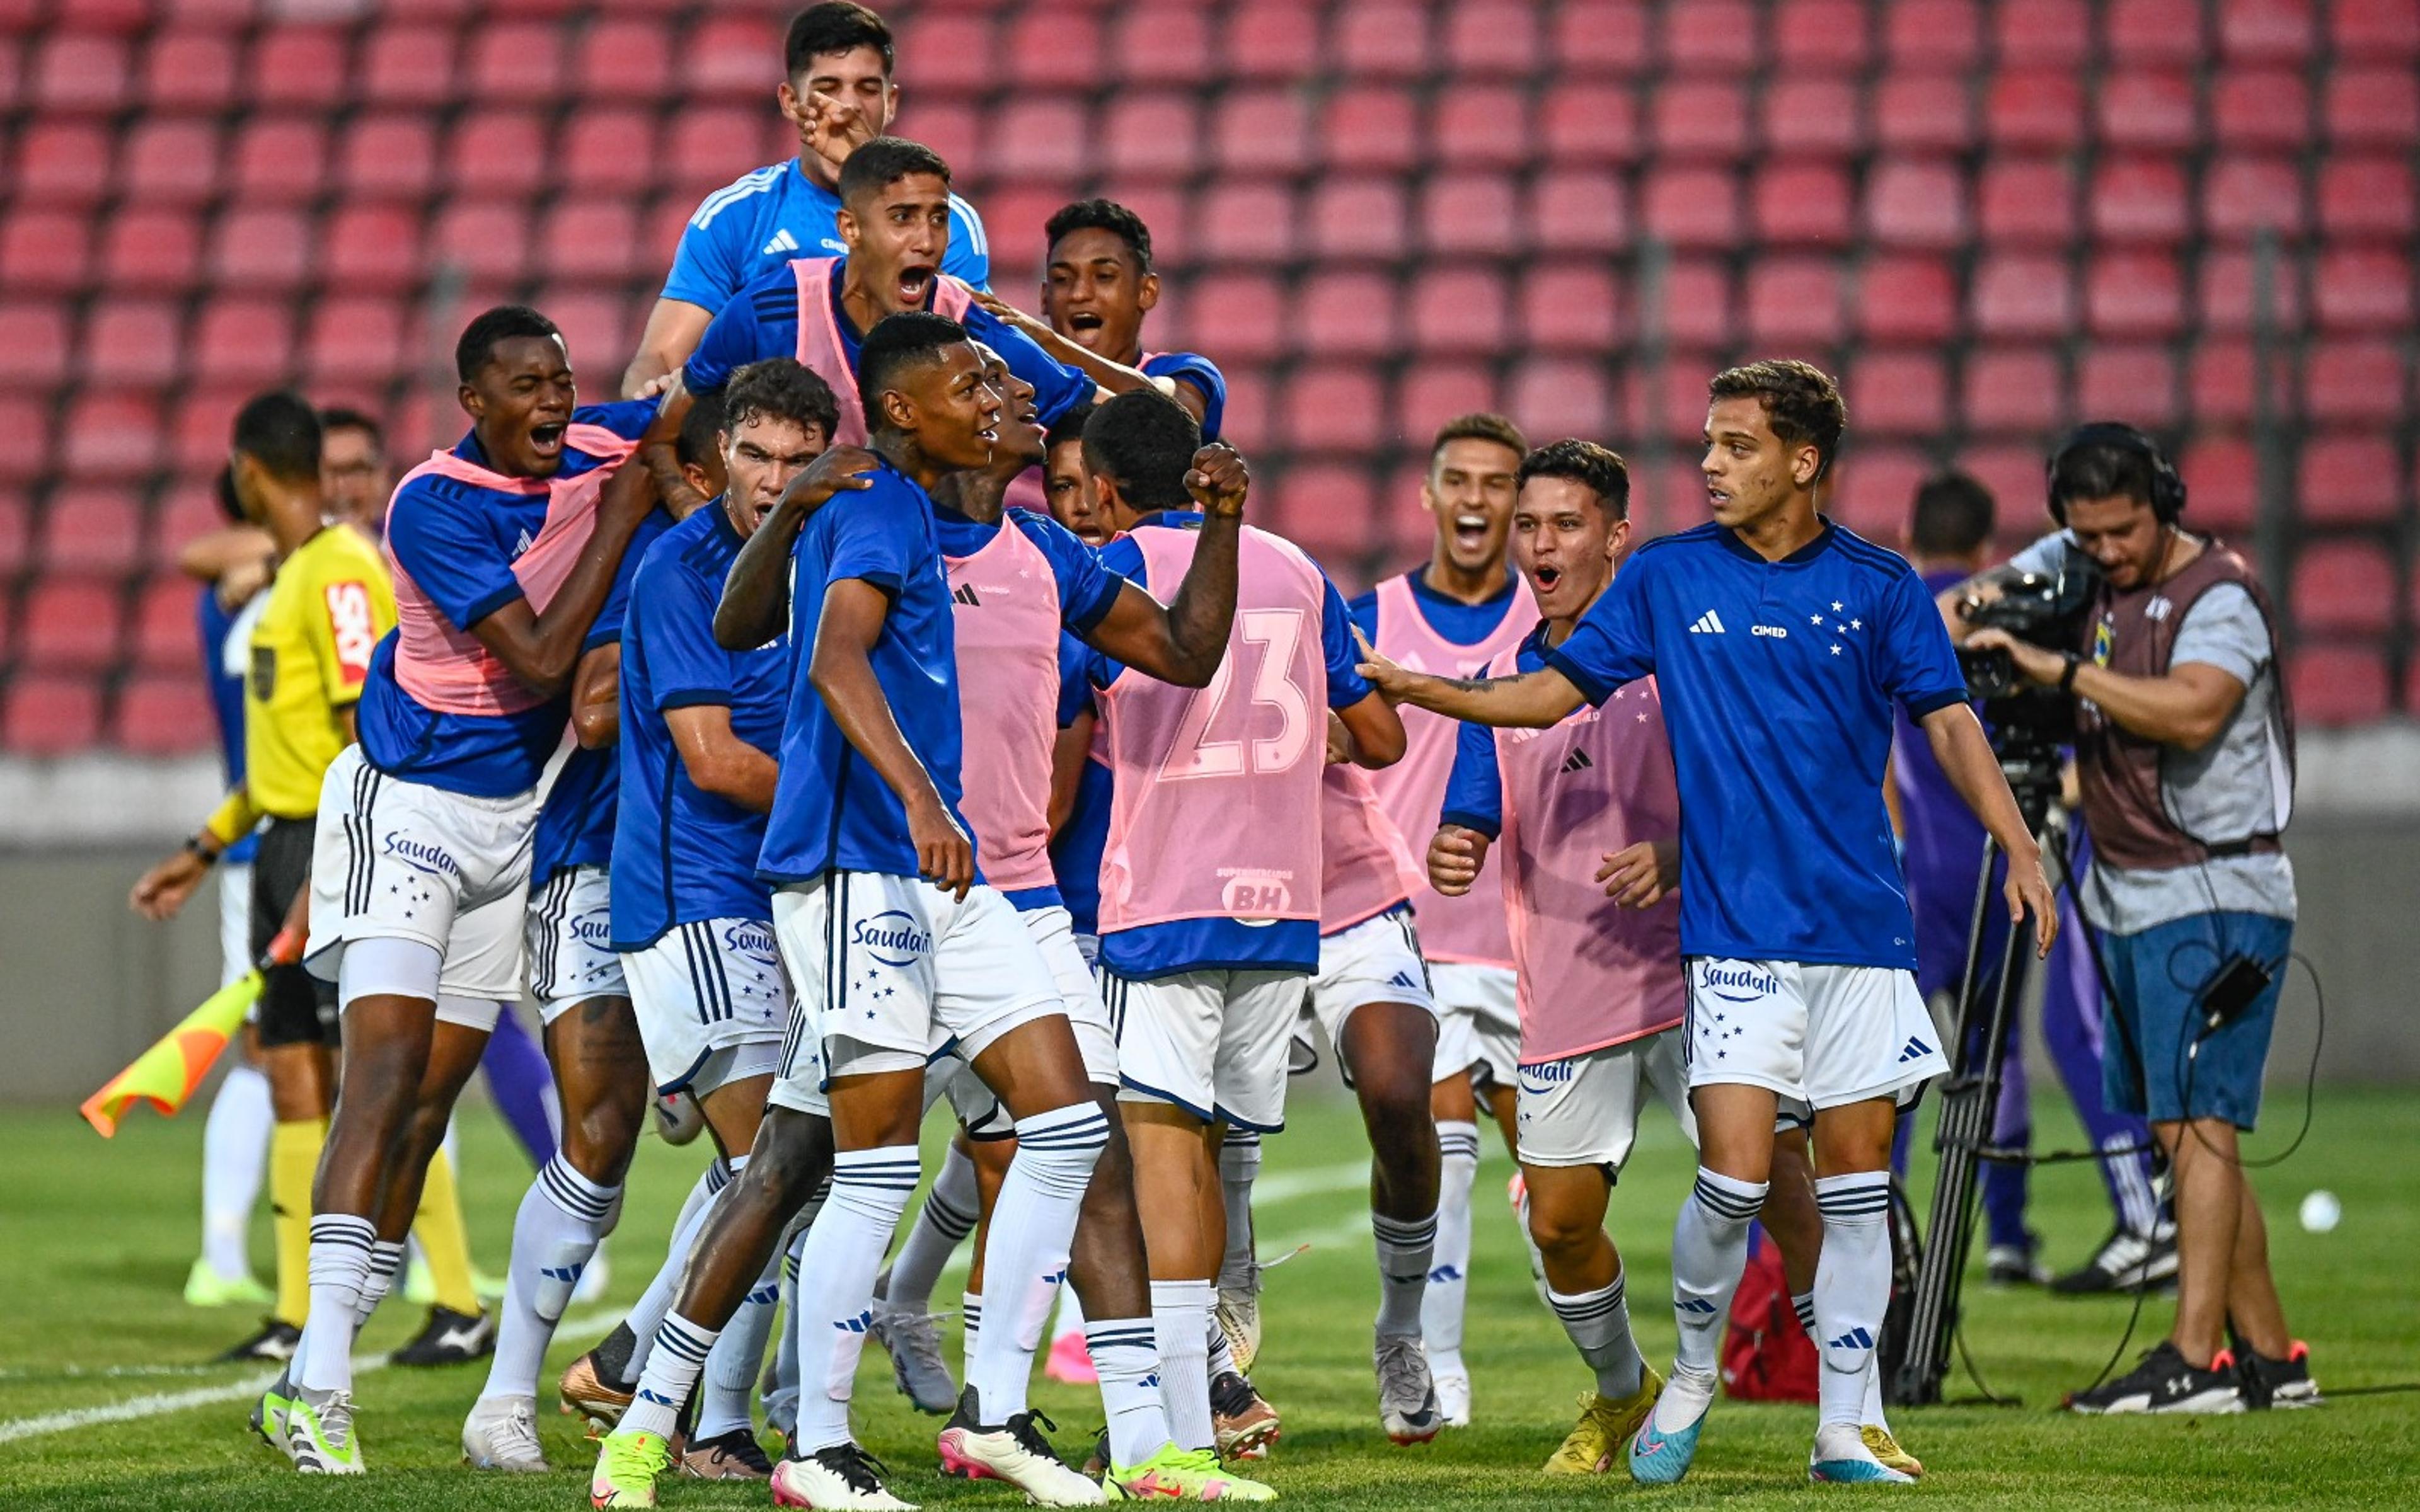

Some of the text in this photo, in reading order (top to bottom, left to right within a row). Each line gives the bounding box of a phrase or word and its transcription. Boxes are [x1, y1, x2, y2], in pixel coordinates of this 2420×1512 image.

[1751, 625, 1787, 639] CIMED
[1155, 607, 1311, 782] 23
[1231, 885, 1282, 911] BH
[1700, 962, 1778, 994] Saudali
